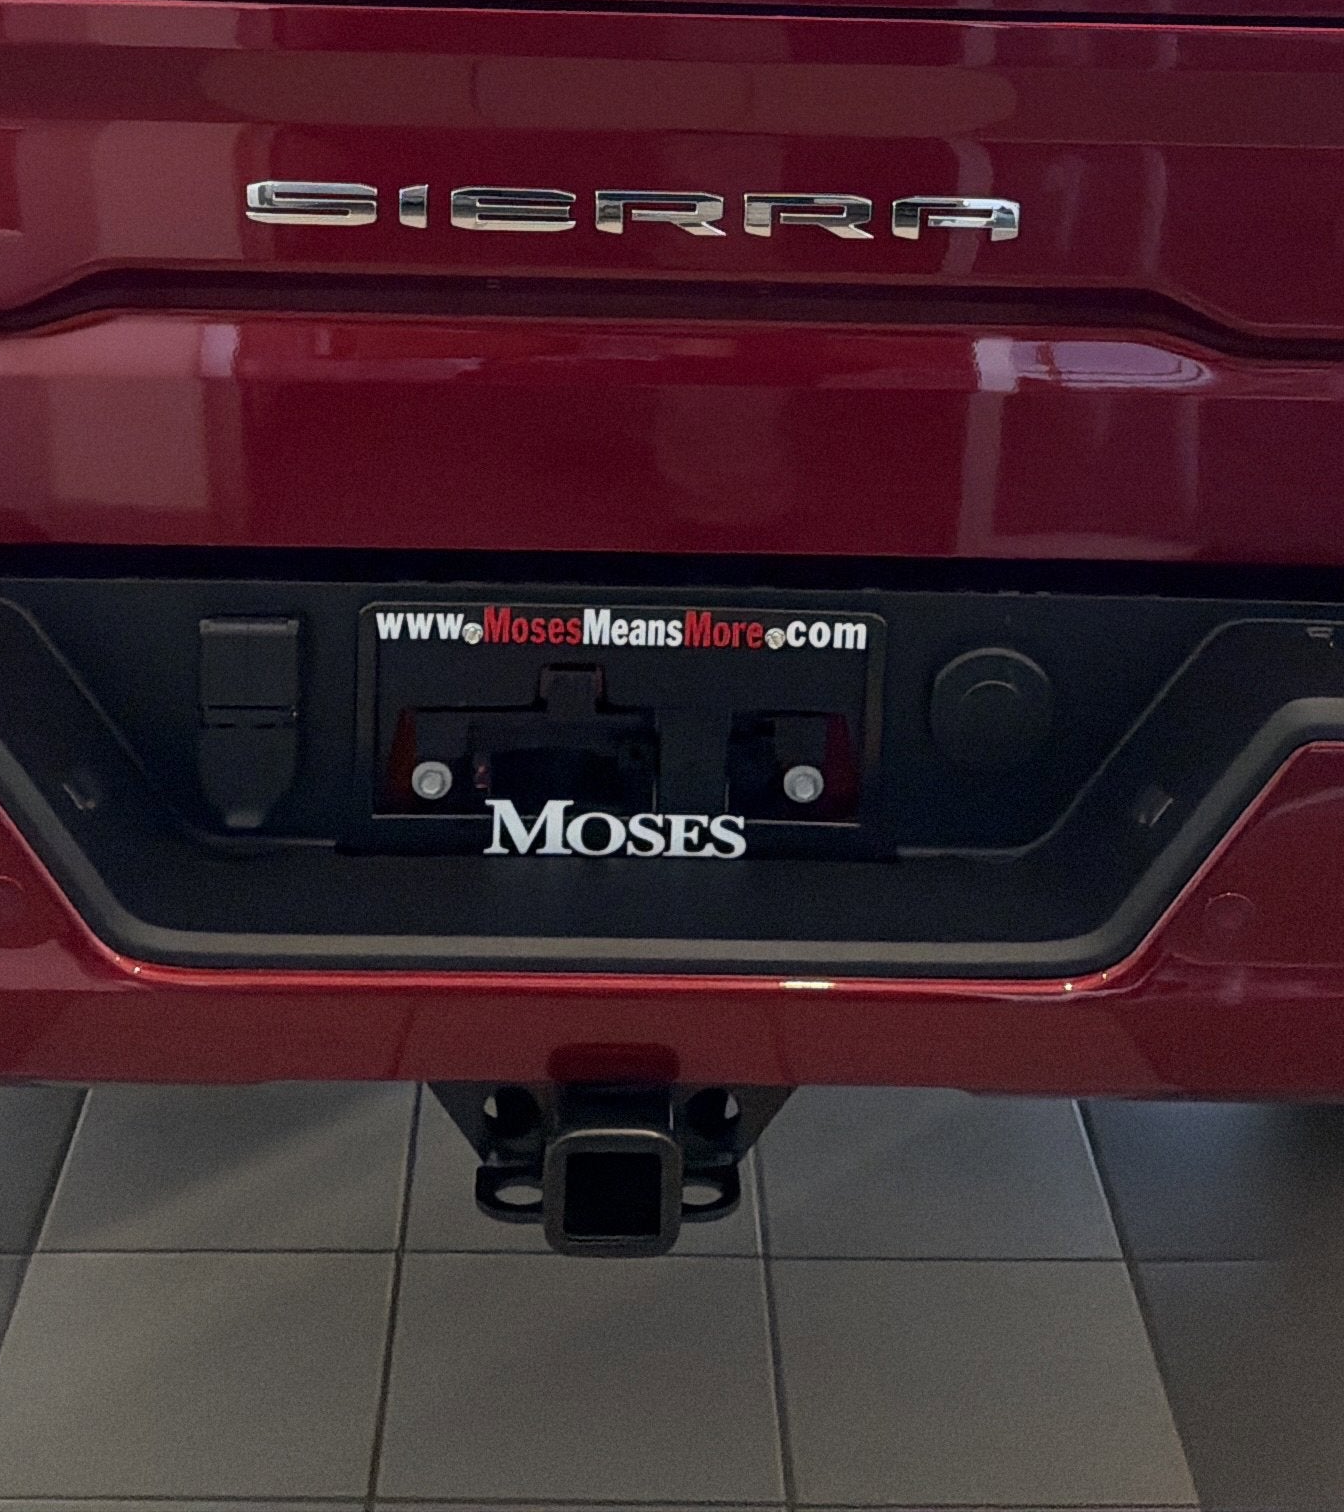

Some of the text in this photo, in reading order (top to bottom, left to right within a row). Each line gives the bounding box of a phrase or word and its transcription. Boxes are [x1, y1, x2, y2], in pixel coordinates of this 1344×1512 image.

[245, 180, 1021, 242] SIERRA
[375, 607, 867, 650] www.MosesMeansMore.com
[484, 798, 747, 859] MOSES
